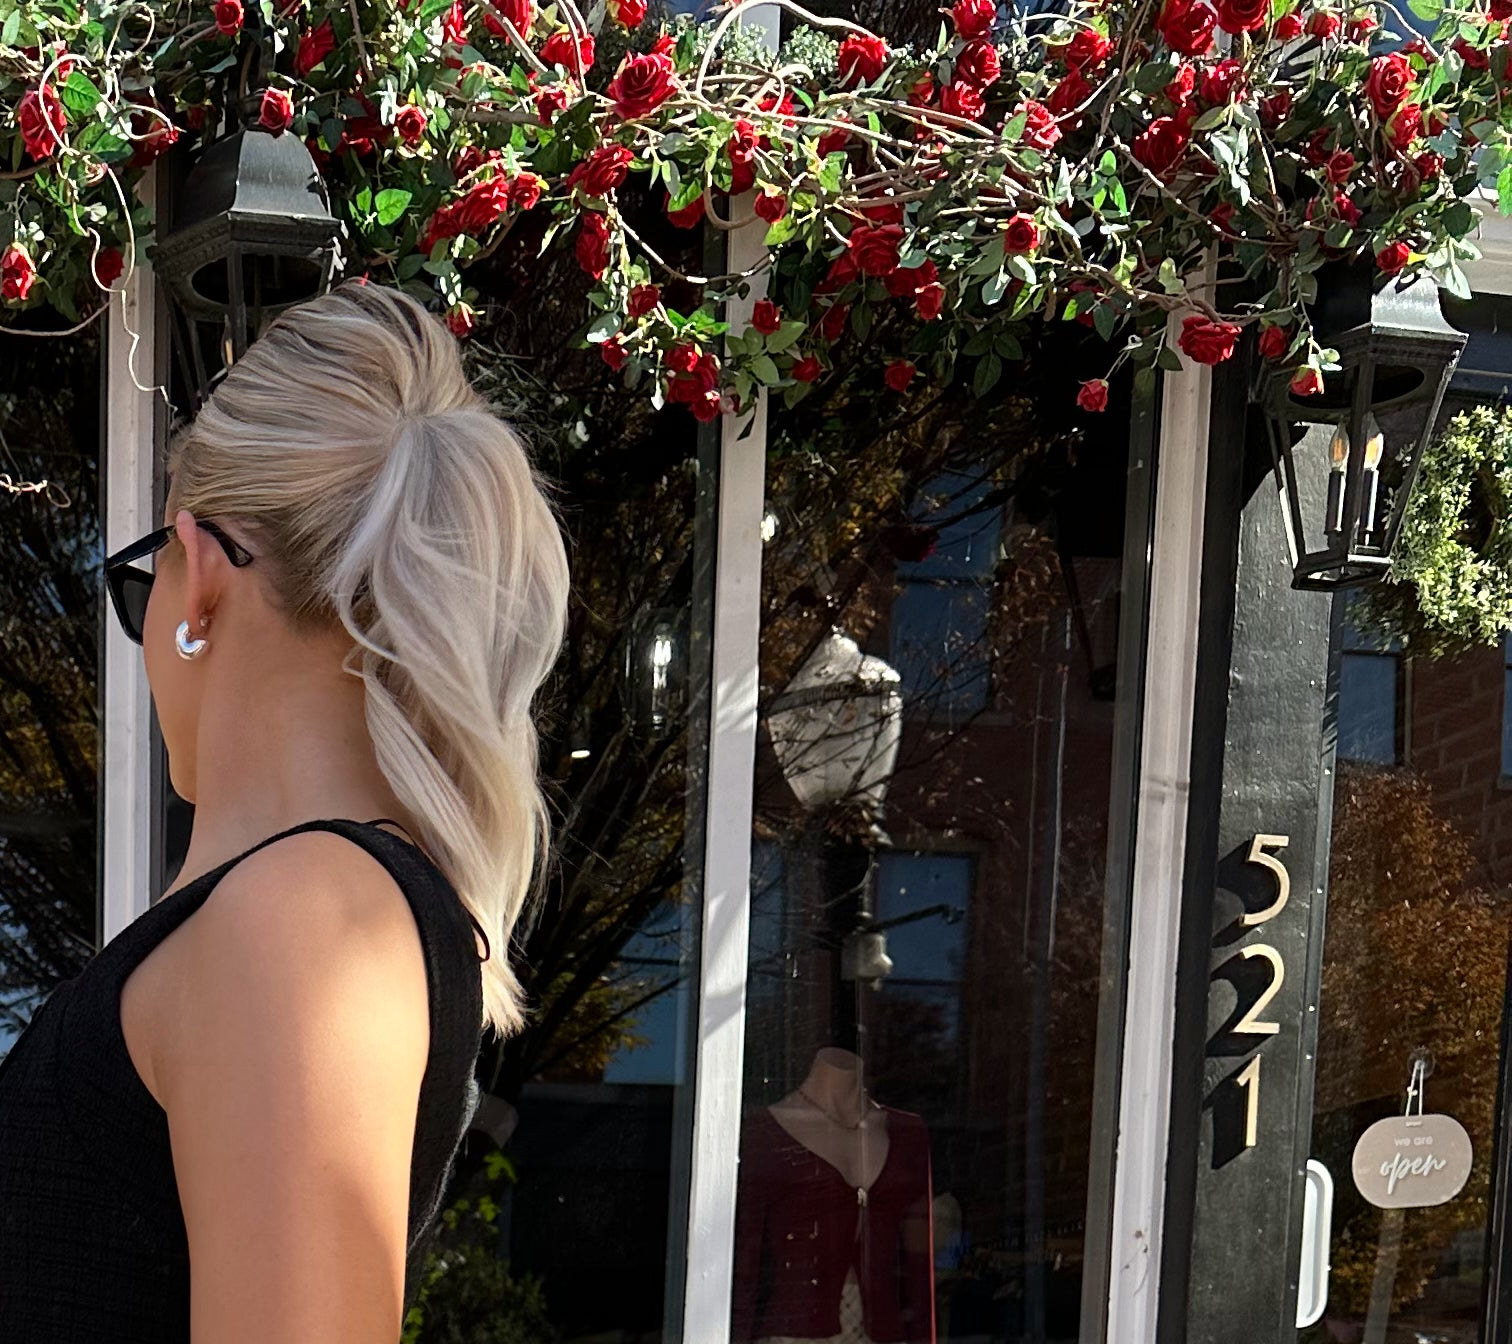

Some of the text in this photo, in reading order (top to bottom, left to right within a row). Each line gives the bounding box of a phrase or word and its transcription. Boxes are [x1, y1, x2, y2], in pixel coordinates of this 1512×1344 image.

[1231, 833, 1290, 1147] 521
[1394, 1135, 1434, 1147] we are
[1379, 1152, 1447, 1196] open
